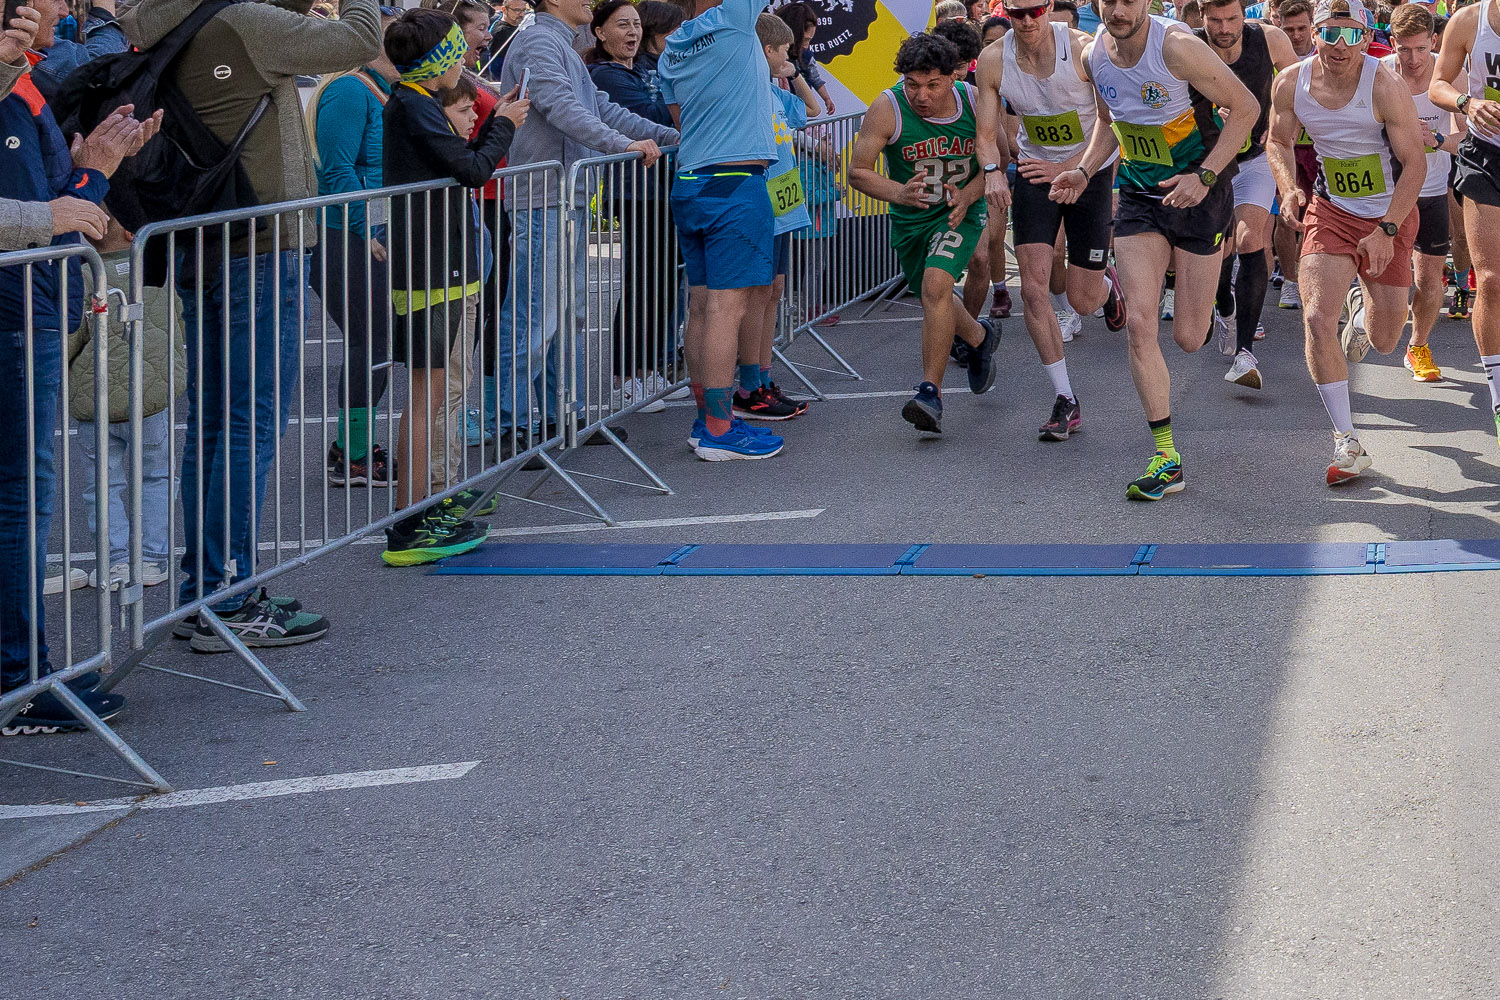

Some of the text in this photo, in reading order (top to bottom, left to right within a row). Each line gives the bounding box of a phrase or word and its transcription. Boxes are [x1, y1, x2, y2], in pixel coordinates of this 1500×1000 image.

[816, 16, 833, 26] 899
[827, 29, 853, 50] RUETZ
[1034, 123, 1073, 143] 883
[901, 136, 975, 162] CHICAG
[1126, 134, 1162, 160] 701
[1334, 169, 1375, 194] 864
[775, 182, 800, 211] 522
